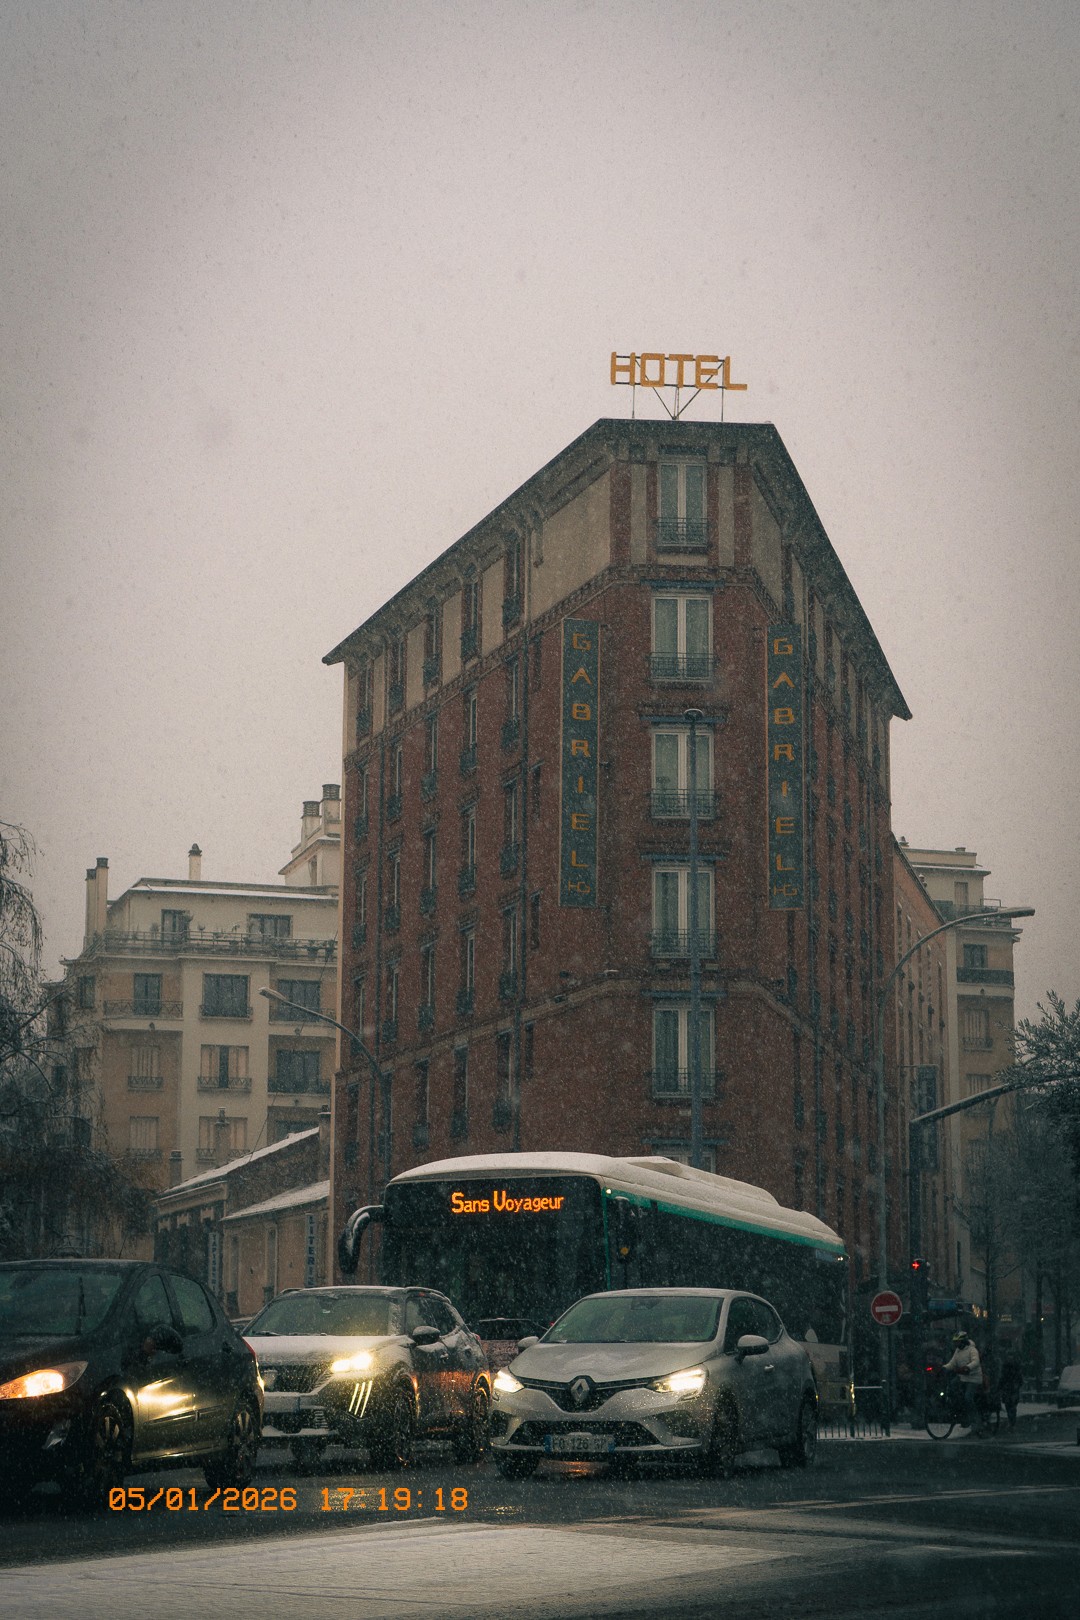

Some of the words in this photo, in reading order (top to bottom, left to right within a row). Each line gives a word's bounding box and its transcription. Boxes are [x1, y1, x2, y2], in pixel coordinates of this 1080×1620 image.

[610, 351, 748, 391] HOTEL
[570, 632, 592, 868] GABRIEL
[772, 636, 796, 871] GABRIEL
[451, 1191, 490, 1213] Sans
[493, 1190, 564, 1213] Voyageur
